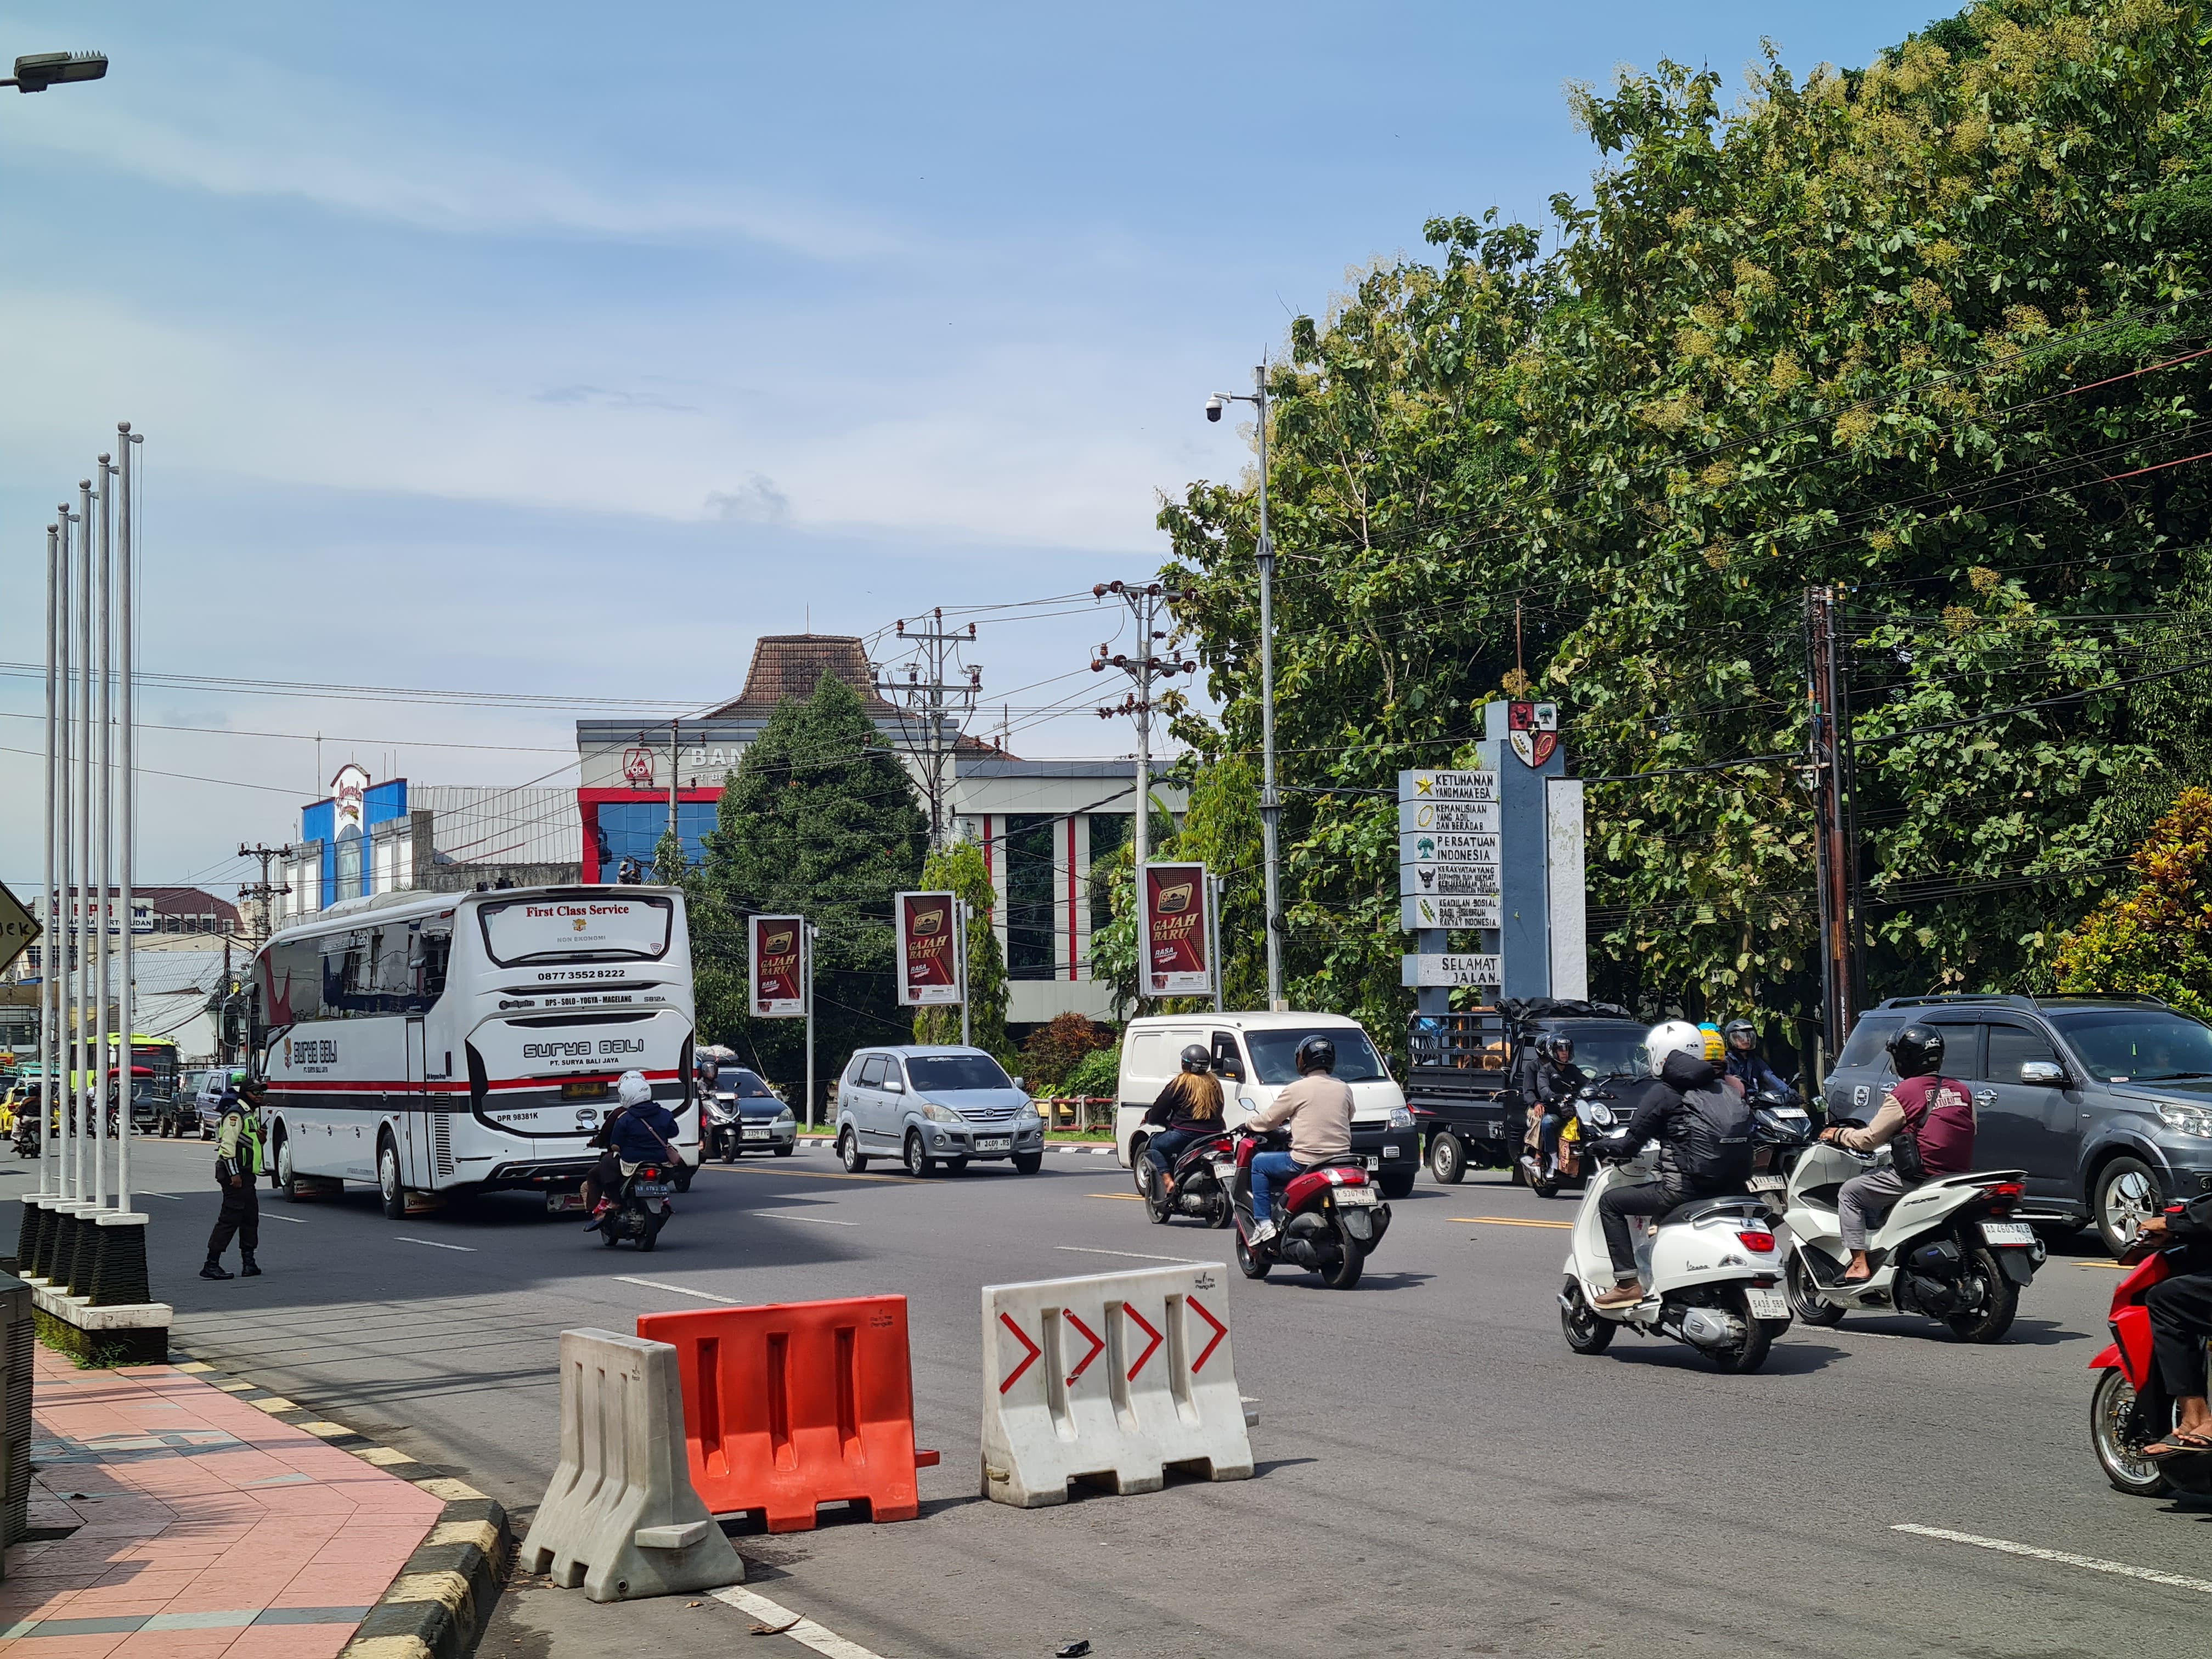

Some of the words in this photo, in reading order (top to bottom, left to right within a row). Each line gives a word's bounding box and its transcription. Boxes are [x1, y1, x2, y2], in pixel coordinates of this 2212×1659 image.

[1435, 774, 1493, 786] KETUHANAN
[1435, 787, 1451, 798] YANG
[1453, 788, 1473, 799] MAHA
[1436, 804, 1486, 814] KEMANUSIAAN
[1437, 813, 1452, 821] YANG
[1455, 814, 1470, 822] ADIL
[1436, 822, 1449, 830] DAN
[1452, 822, 1483, 830] BERADAB
[1437, 836, 1495, 847] PERSATUAN
[1437, 849, 1490, 860] INDONESIA
[526, 906, 554, 918] First
[556, 905, 587, 917] Class
[589, 905, 629, 915] Service
[1153, 913, 1199, 931] GAJAH
[1465, 918, 1496, 926] INDONESIA
[1152, 928, 1191, 941] BARU
[909, 935, 949, 951] GAJAH
[908, 948, 941, 959] BARU
[1155, 947, 1174, 957] RASA
[760, 954, 797, 969] GAJAH
[1442, 958, 1497, 970] SELAMAT
[760, 966, 791, 976] BARU
[910, 964, 927, 973] RASA
[538, 972, 566, 981] 0877
[568, 971, 595, 979] 3552
[597, 970, 625, 978] 8222
[1985, 1224, 1996, 1233] AA
[1997, 1224, 2015, 1233] 4603
[2016, 1224, 2030, 1233] ALB
